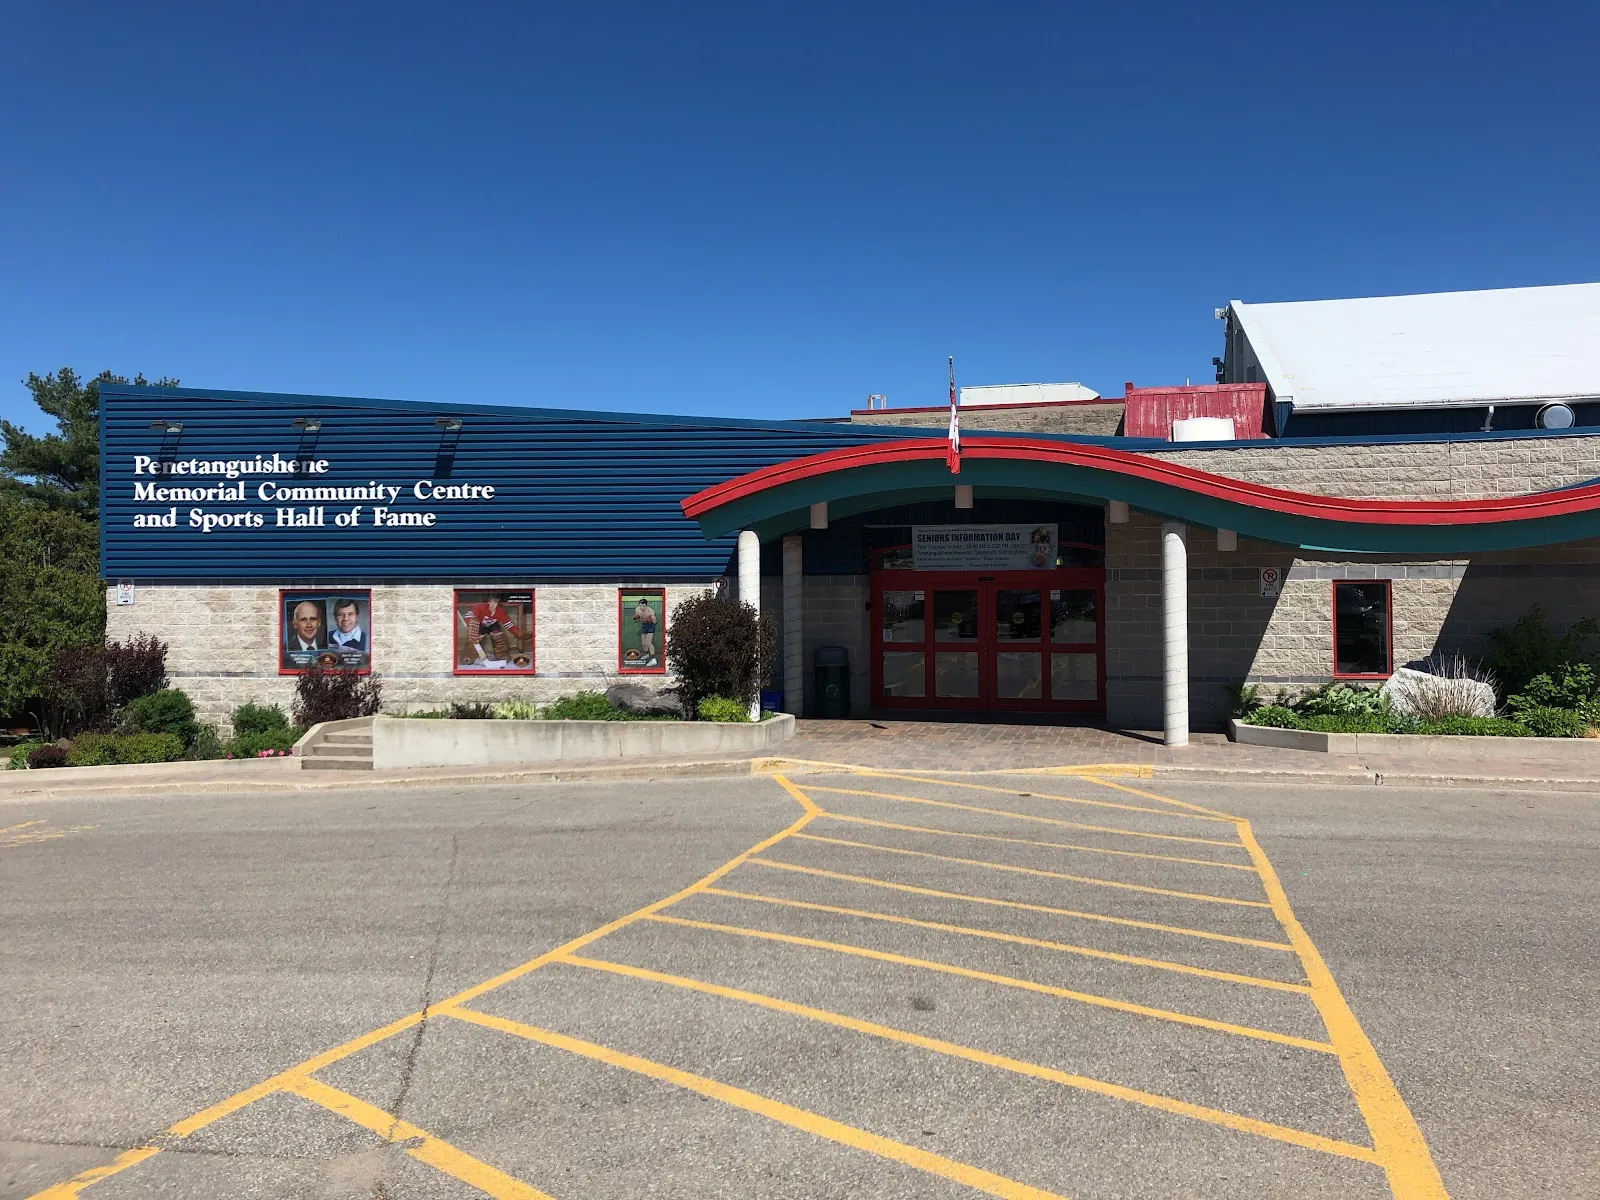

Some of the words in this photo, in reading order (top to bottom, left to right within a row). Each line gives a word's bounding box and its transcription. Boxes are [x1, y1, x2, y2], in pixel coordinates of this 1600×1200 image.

[133, 453, 329, 479] Penetanguishene
[133, 480, 247, 502] Memorial
[257, 480, 402, 504] Community
[413, 480, 495, 501] Centre
[133, 507, 178, 528] and
[189, 507, 264, 533] Sports
[275, 506, 326, 528] Hall
[334, 506, 363, 528] of
[372, 506, 437, 528] Fame
[917, 533, 950, 543] SENIORS
[951, 533, 1004, 542] INFORMATION
[1005, 532, 1021, 541] DAY
